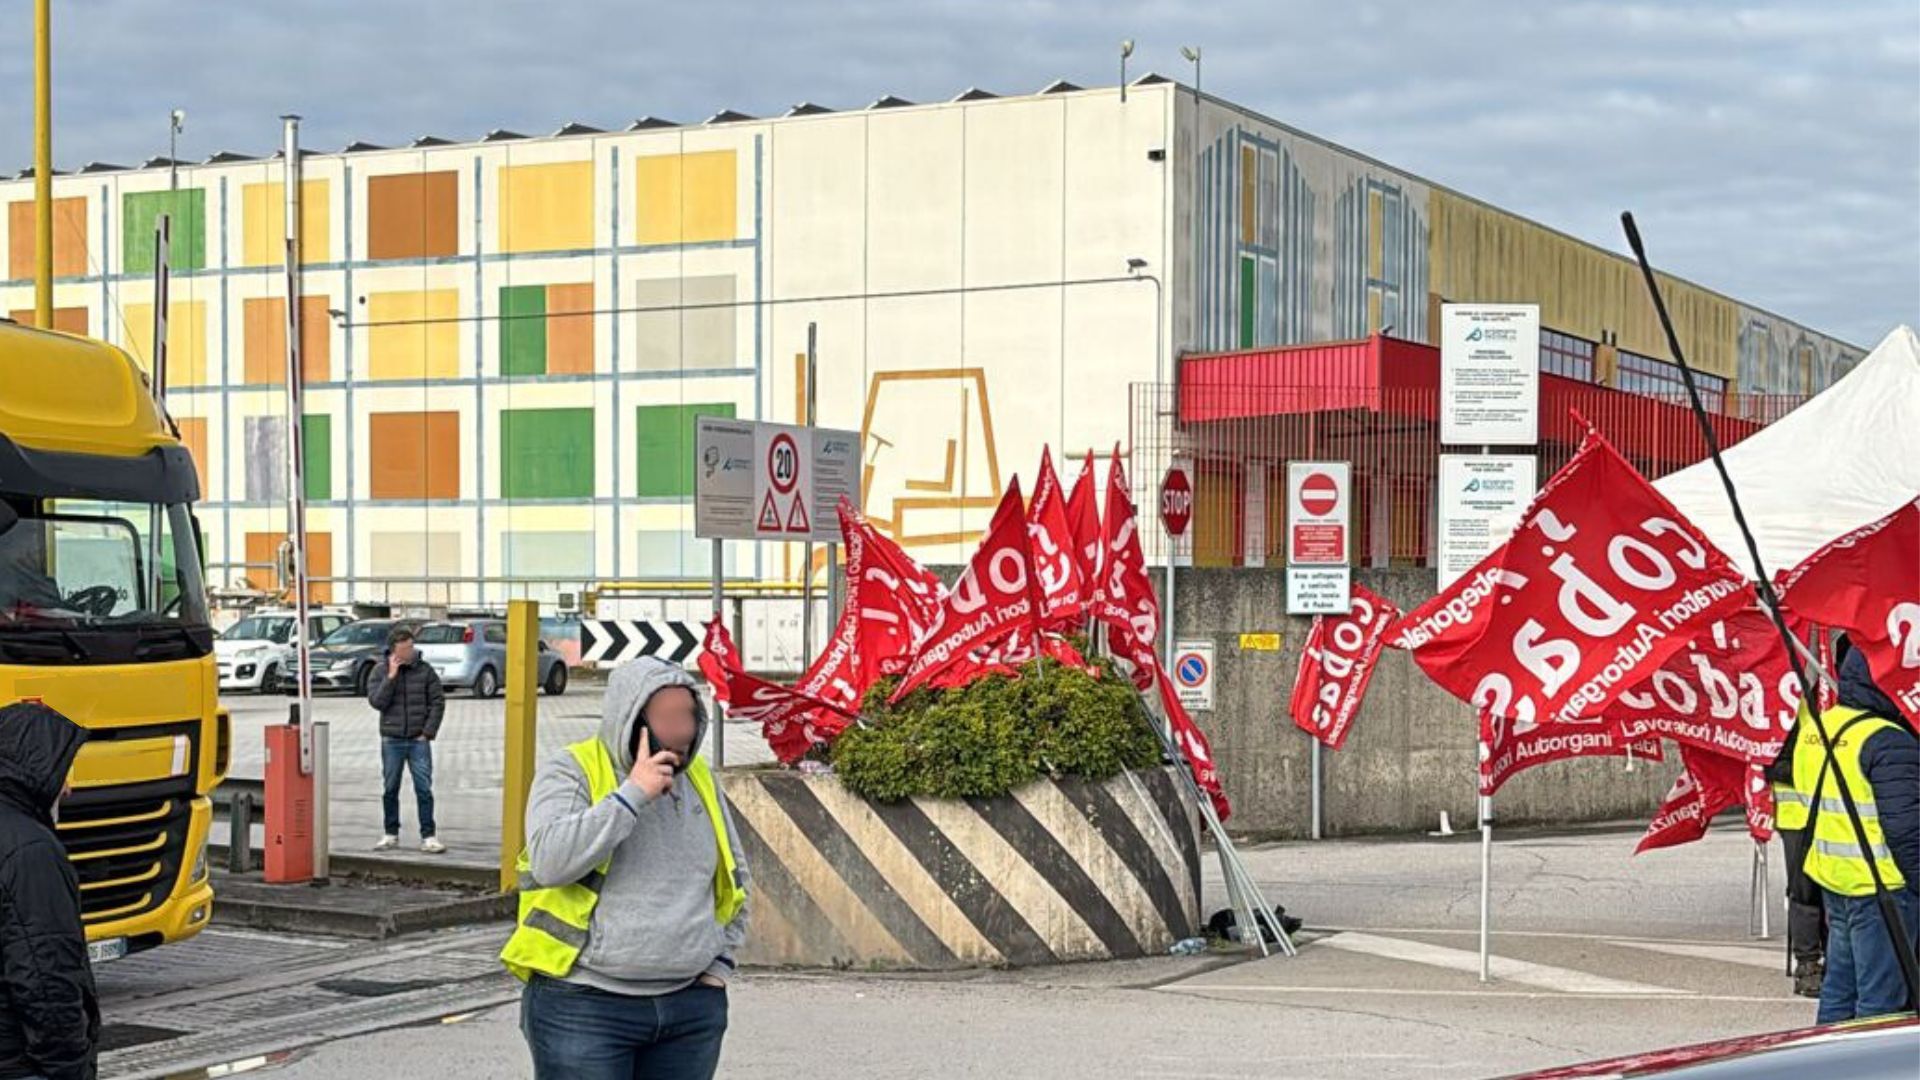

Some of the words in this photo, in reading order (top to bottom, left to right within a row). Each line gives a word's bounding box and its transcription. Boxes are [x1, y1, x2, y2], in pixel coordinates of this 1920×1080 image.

[775, 448, 792, 479] 20
[1163, 489, 1190, 515] STOP
[1515, 730, 1613, 762] Autorgani
